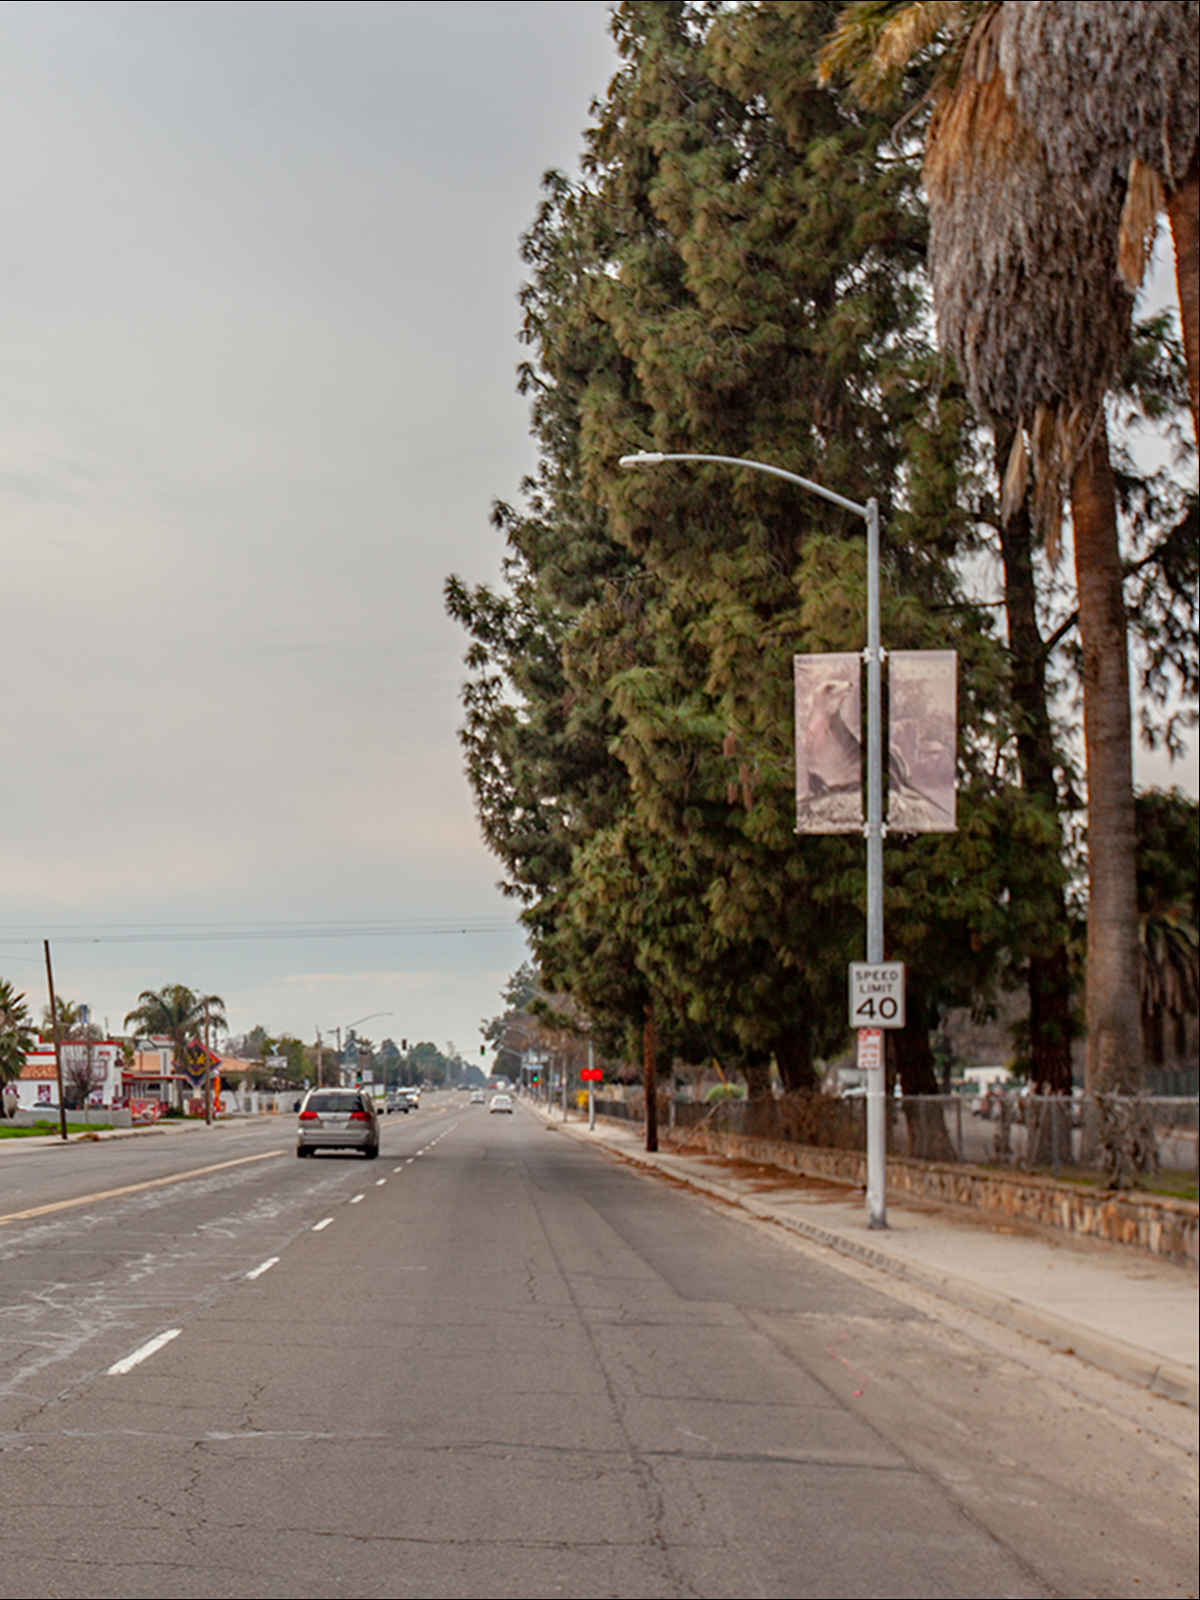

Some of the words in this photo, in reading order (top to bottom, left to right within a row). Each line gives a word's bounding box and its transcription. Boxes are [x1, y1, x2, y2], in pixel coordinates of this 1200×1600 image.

[855, 969, 899, 981] SPEED
[859, 983, 893, 994] LIMIT
[856, 996, 898, 1019] 40
